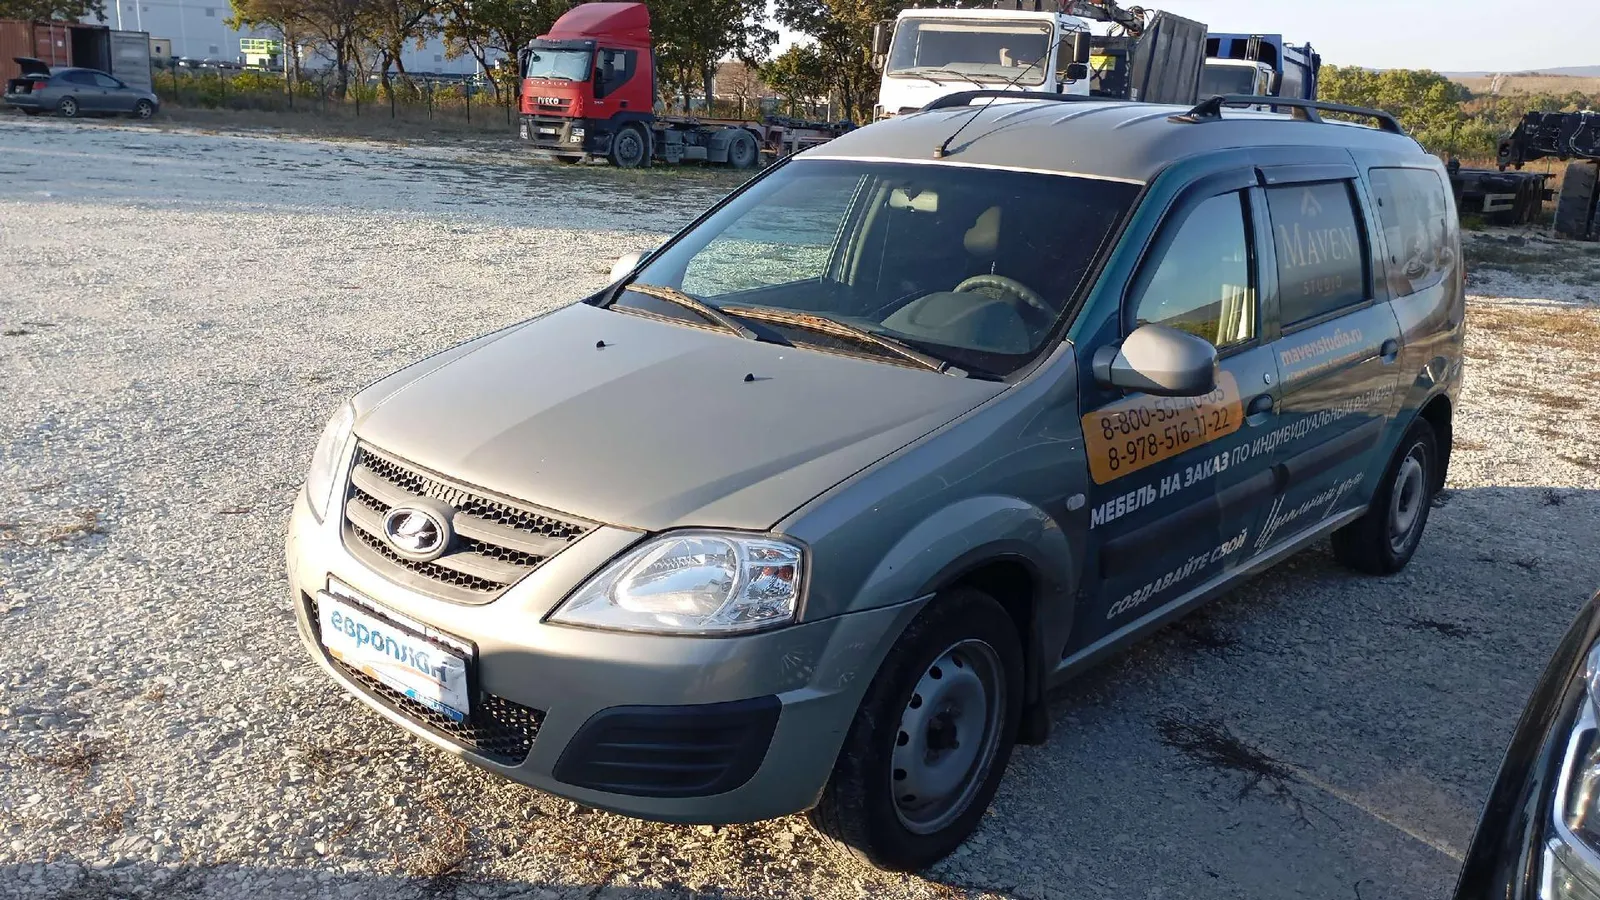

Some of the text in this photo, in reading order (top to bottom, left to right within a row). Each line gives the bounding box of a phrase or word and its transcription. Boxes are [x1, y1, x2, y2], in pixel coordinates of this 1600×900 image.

[537, 96, 559, 105] IVECO
[1303, 275, 1343, 295] STUDIO
[1280, 327, 1363, 366] mavenstudio.ru
[1108, 408, 1231, 471] 8-978-516-11-22
[1090, 483, 1157, 530] МЕБЕЛЬ
[1159, 471, 1182, 498] НА
[1183, 452, 1229, 489] ЗАКАЗ
[1230, 446, 1250, 468] ПО
[1106, 553, 1208, 621] СОЗДАВАЙТЕ
[1210, 528, 1248, 560] СВОЙ
